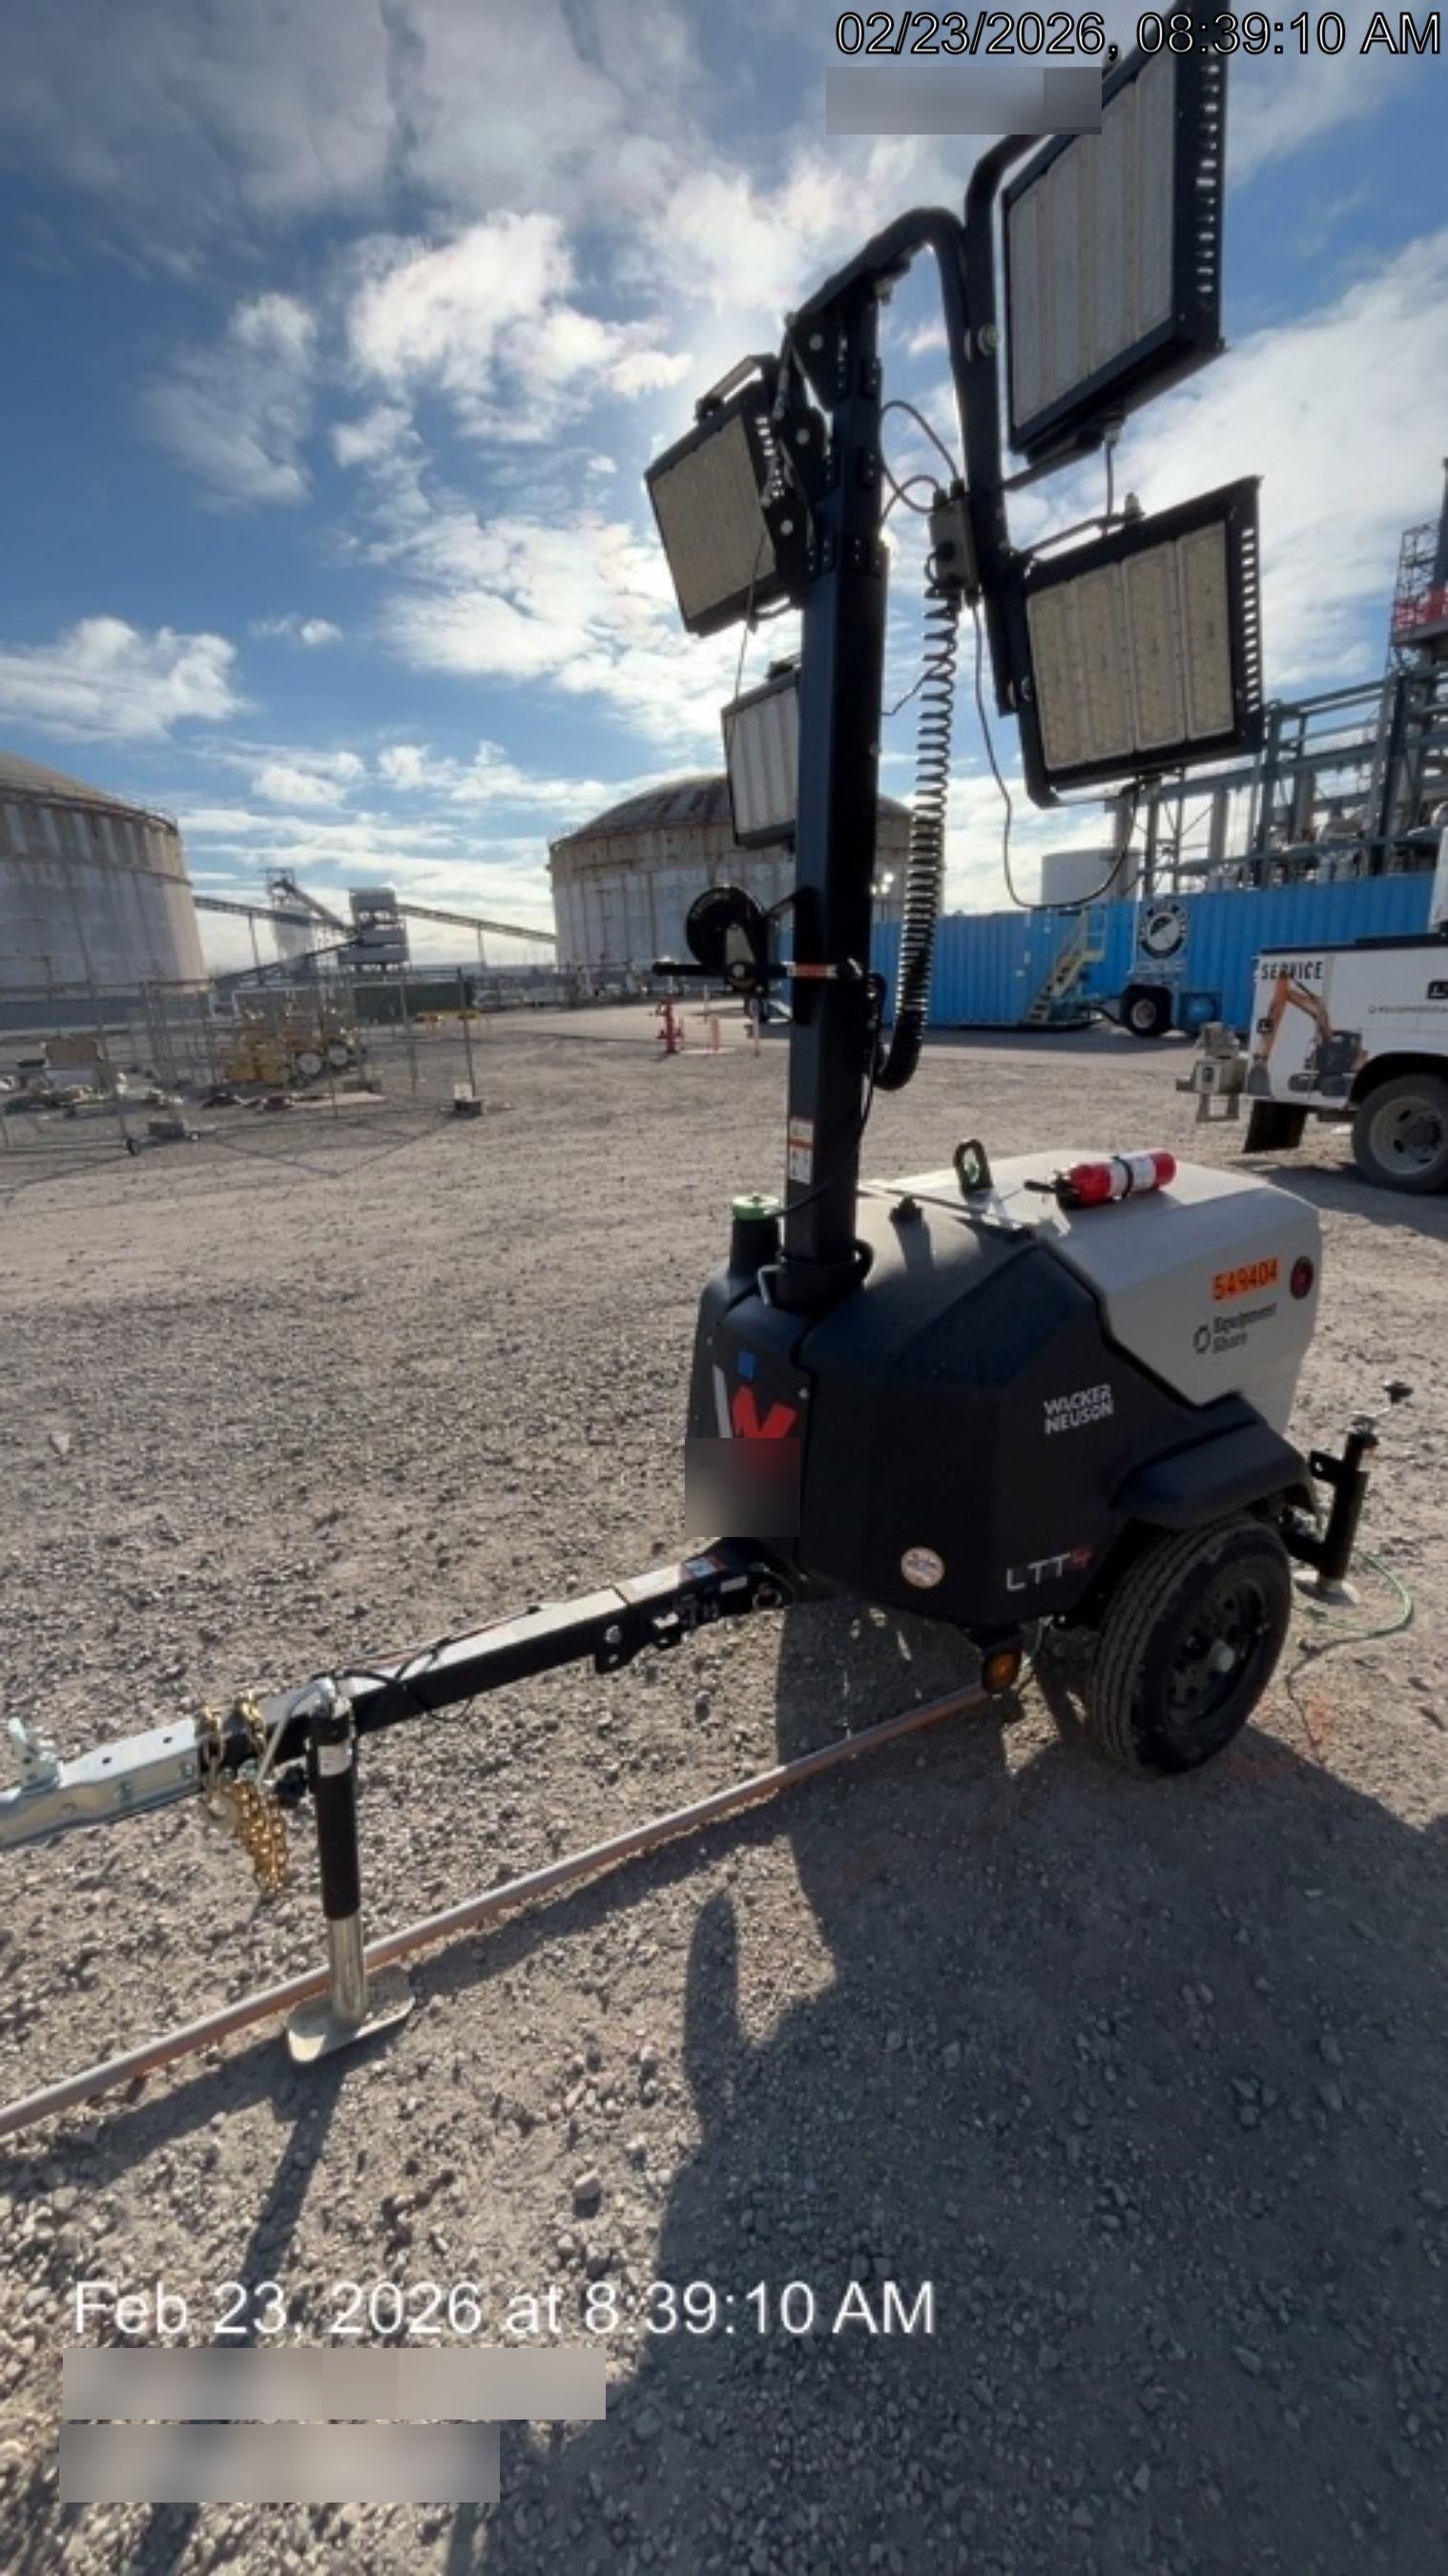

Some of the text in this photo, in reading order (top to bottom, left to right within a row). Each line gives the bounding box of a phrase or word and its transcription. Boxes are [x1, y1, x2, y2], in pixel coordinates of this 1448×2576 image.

[1261, 961, 1323, 980] SERVICE
[1044, 1384, 1111, 1416] WACKER
[1044, 1401, 1114, 1435] NEUSON
